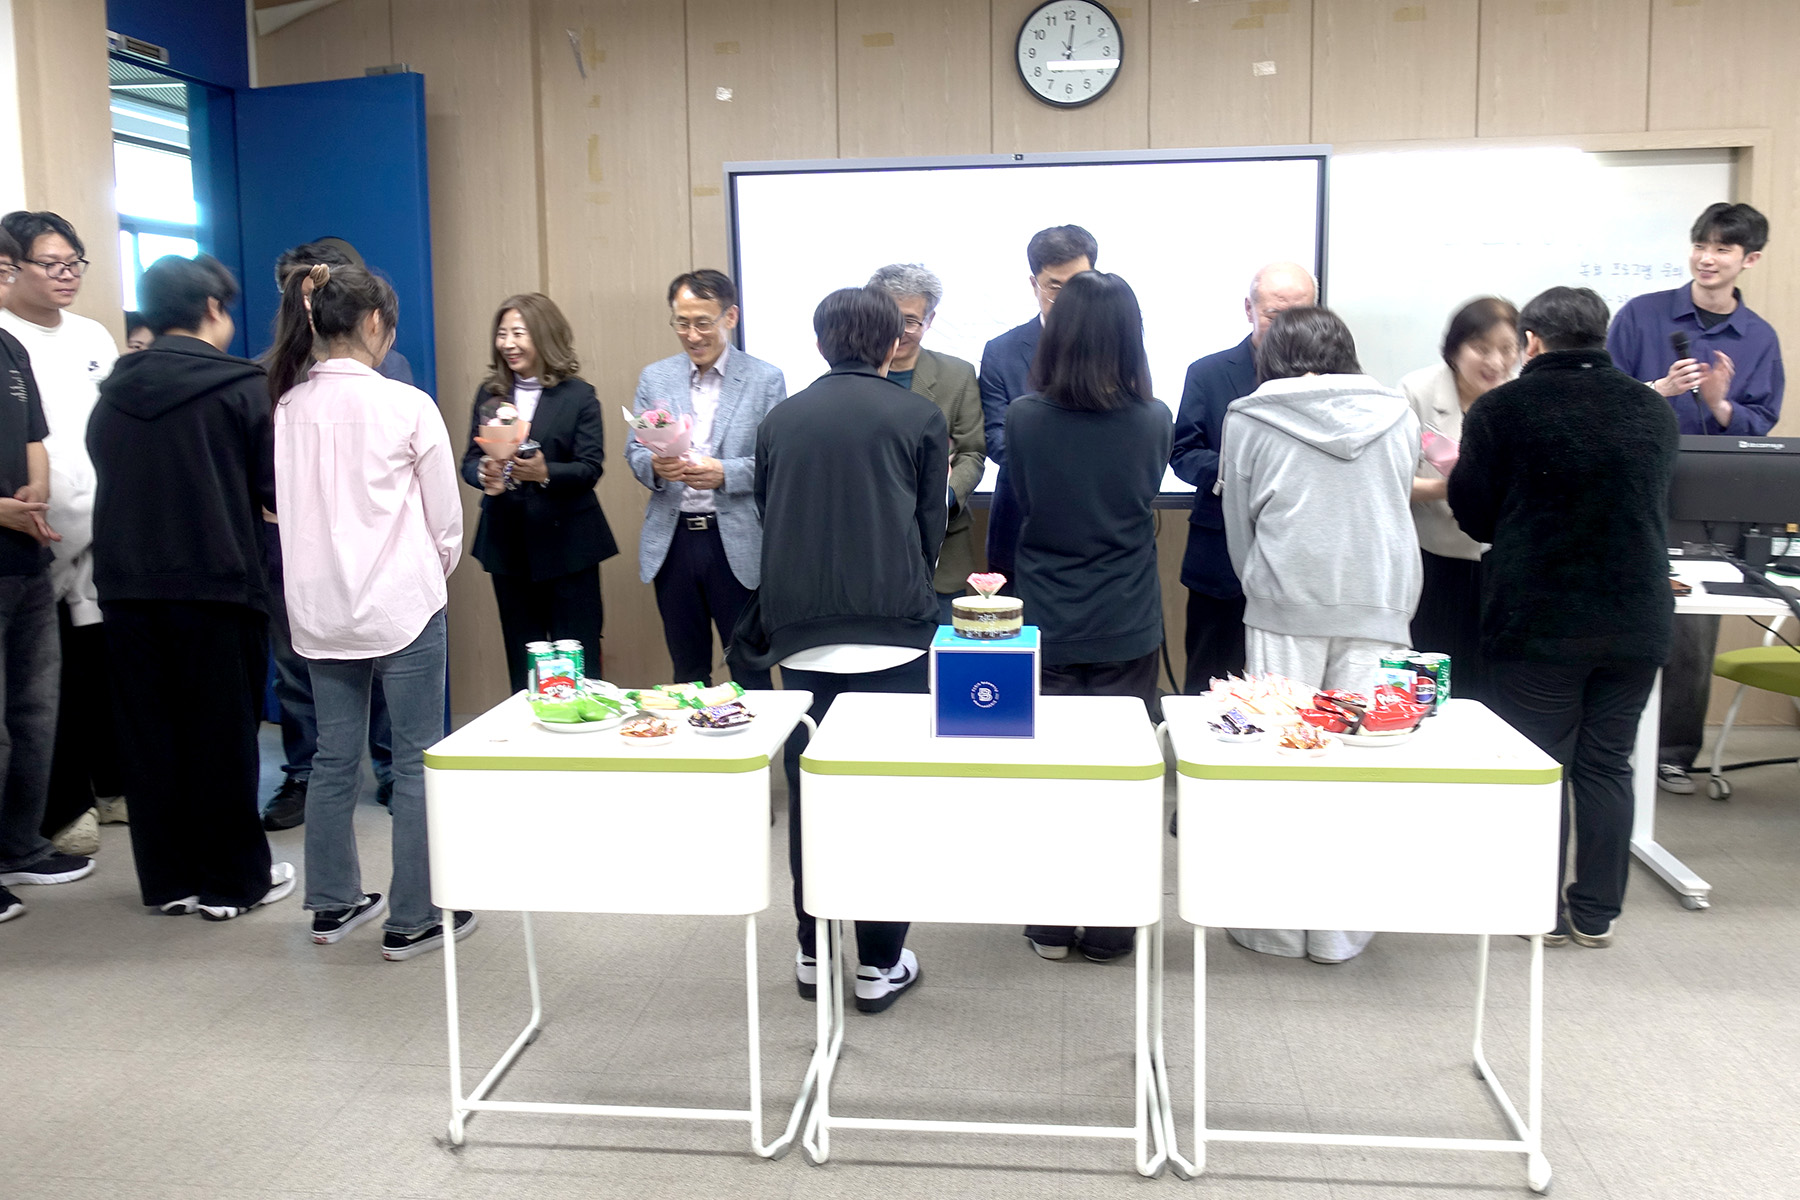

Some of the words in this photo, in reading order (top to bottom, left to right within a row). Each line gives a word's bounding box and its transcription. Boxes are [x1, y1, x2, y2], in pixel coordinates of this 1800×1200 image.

[1045, 15, 1057, 26] 11
[1064, 10, 1076, 21] 12
[1085, 15, 1091, 25] 1
[1034, 29, 1046, 40] 10
[1097, 27, 1108, 38] 2
[1028, 47, 1036, 59] 9
[1102, 45, 1111, 57] 3
[1033, 66, 1042, 77] 8
[1047, 78, 1054, 90] 7
[1065, 83, 1073, 94] 6
[1083, 78, 1091, 90] 5
